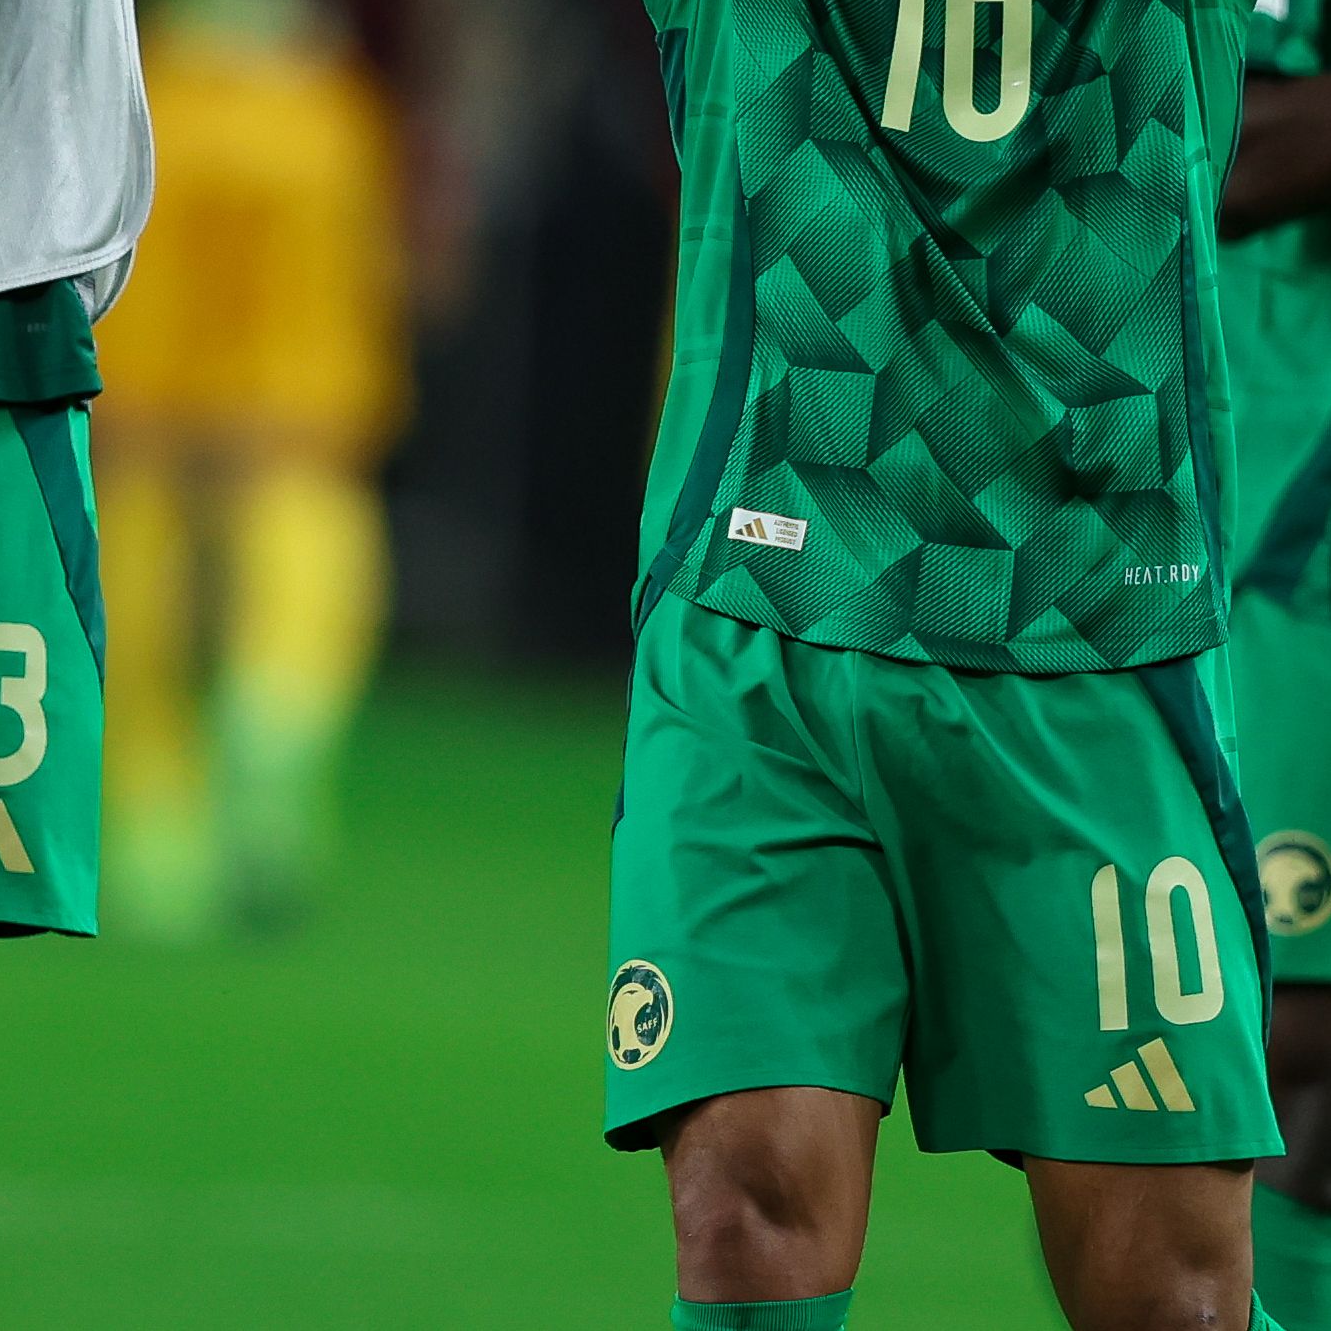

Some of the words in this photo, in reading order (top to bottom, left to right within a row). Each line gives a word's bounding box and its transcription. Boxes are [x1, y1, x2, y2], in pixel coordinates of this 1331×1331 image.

[1124, 563, 1199, 586] HEAT.RDY
[1090, 855, 1224, 1032] 10
[636, 1017, 659, 1034] SAFF
